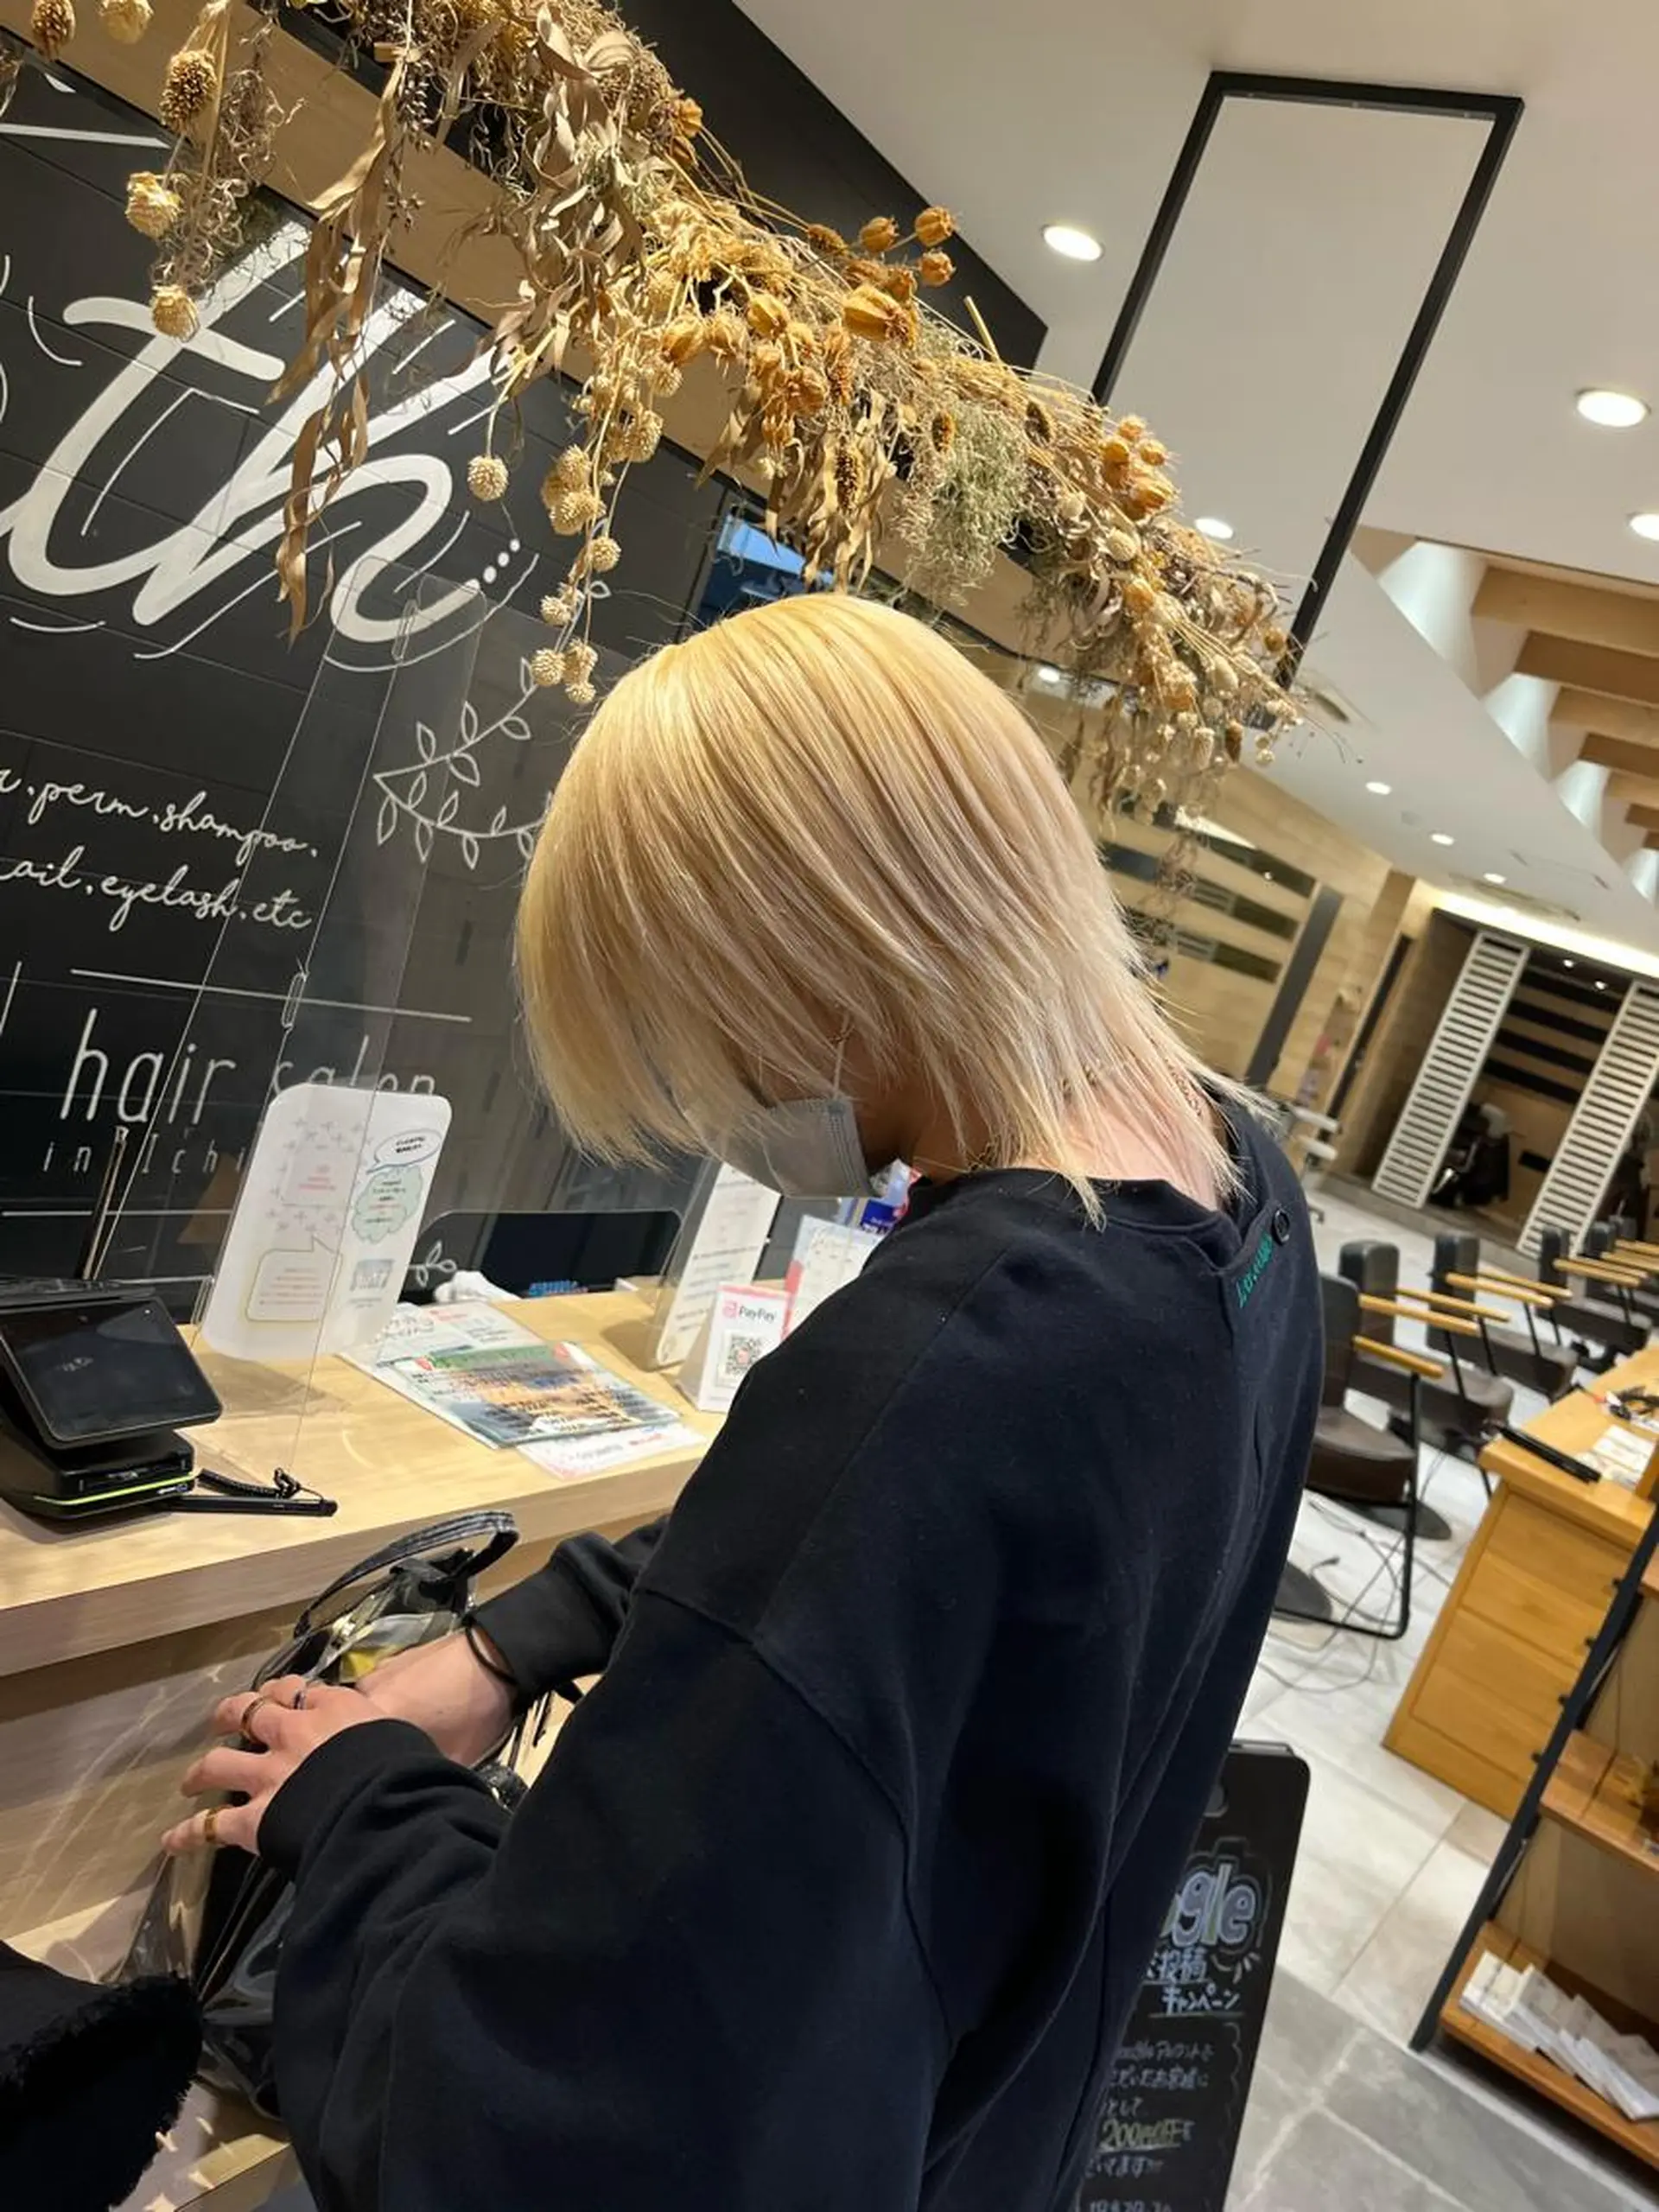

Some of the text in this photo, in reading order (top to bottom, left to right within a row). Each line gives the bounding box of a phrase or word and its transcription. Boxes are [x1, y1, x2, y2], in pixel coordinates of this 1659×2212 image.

[252, 888, 313, 930] etc
[60, 1007, 236, 1124] hair
[42, 1141, 92, 1173] in
[738, 1304, 776, 1325] PayPay
[1159, 1863, 1256, 1948] gle
